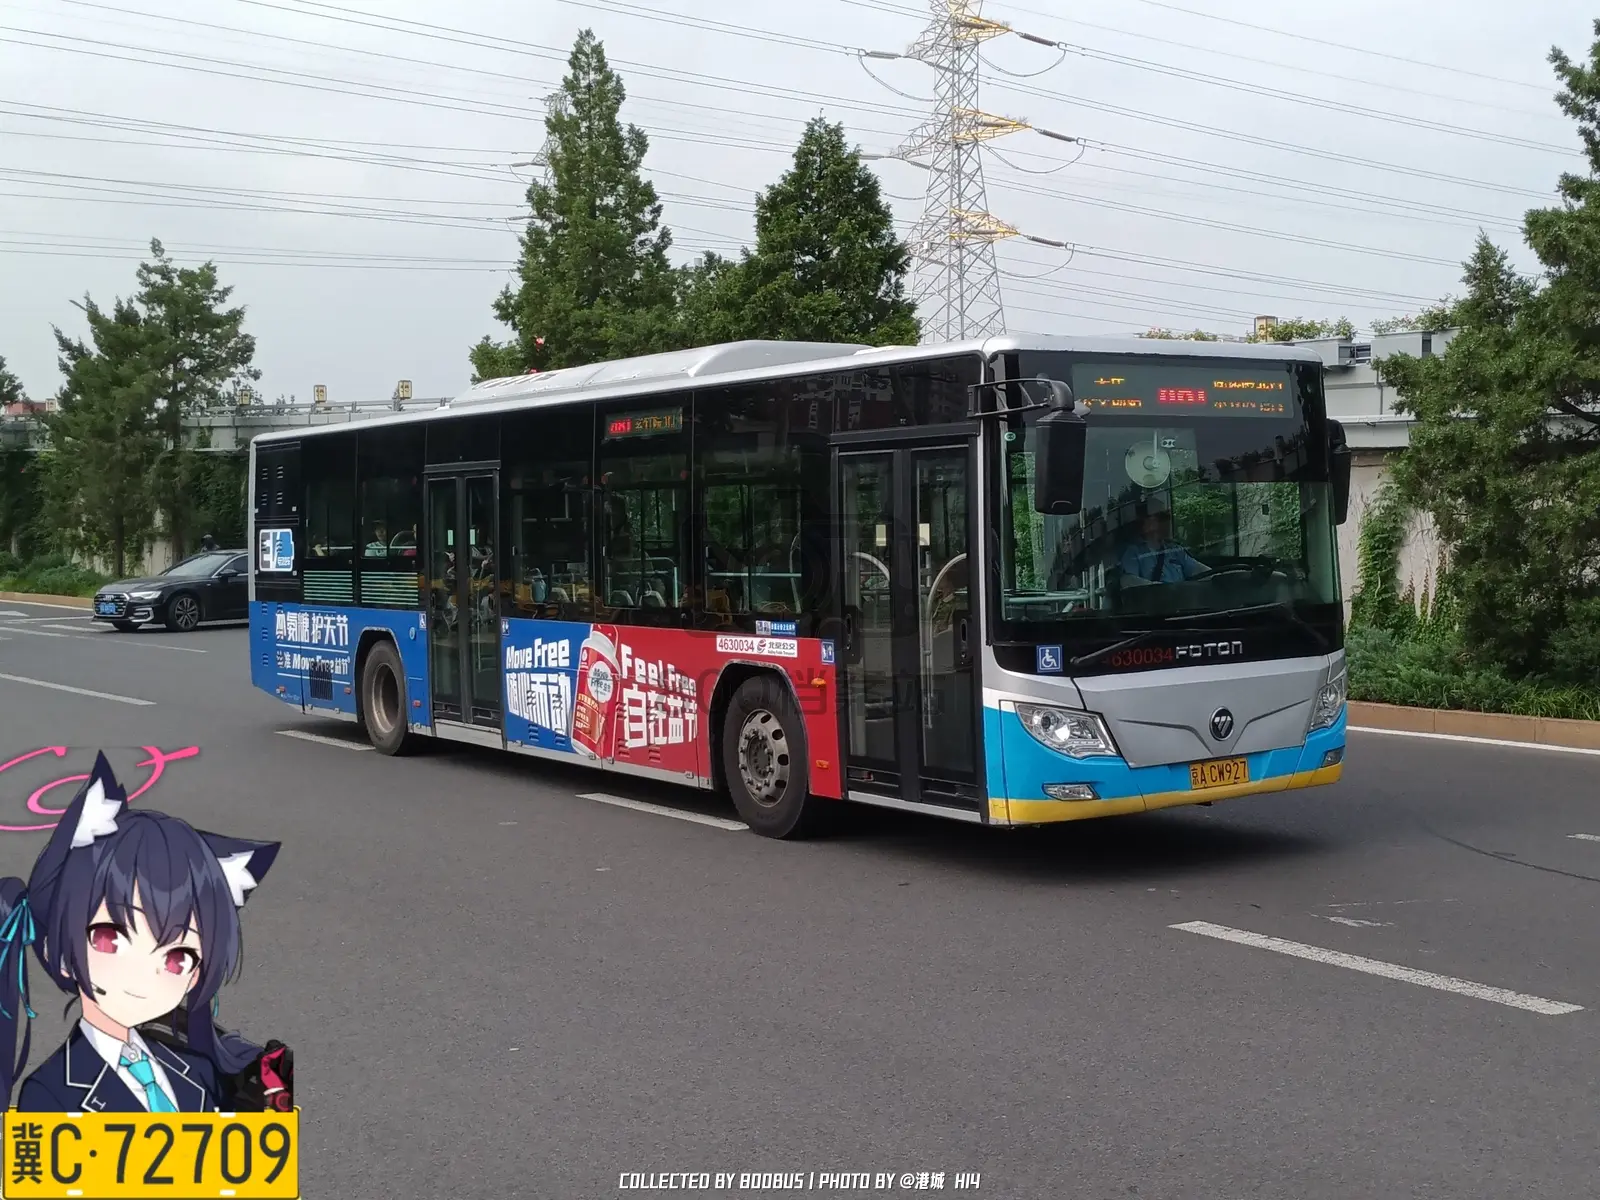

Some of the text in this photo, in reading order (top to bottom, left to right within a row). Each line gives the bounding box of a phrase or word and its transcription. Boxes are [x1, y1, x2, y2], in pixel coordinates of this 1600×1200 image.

[506, 637, 570, 670] Move Free
[718, 639, 755, 652] 4630034
[1176, 641, 1242, 660] FOTON
[620, 643, 664, 688] Feel
[622, 683, 698, 748] 自在益节
